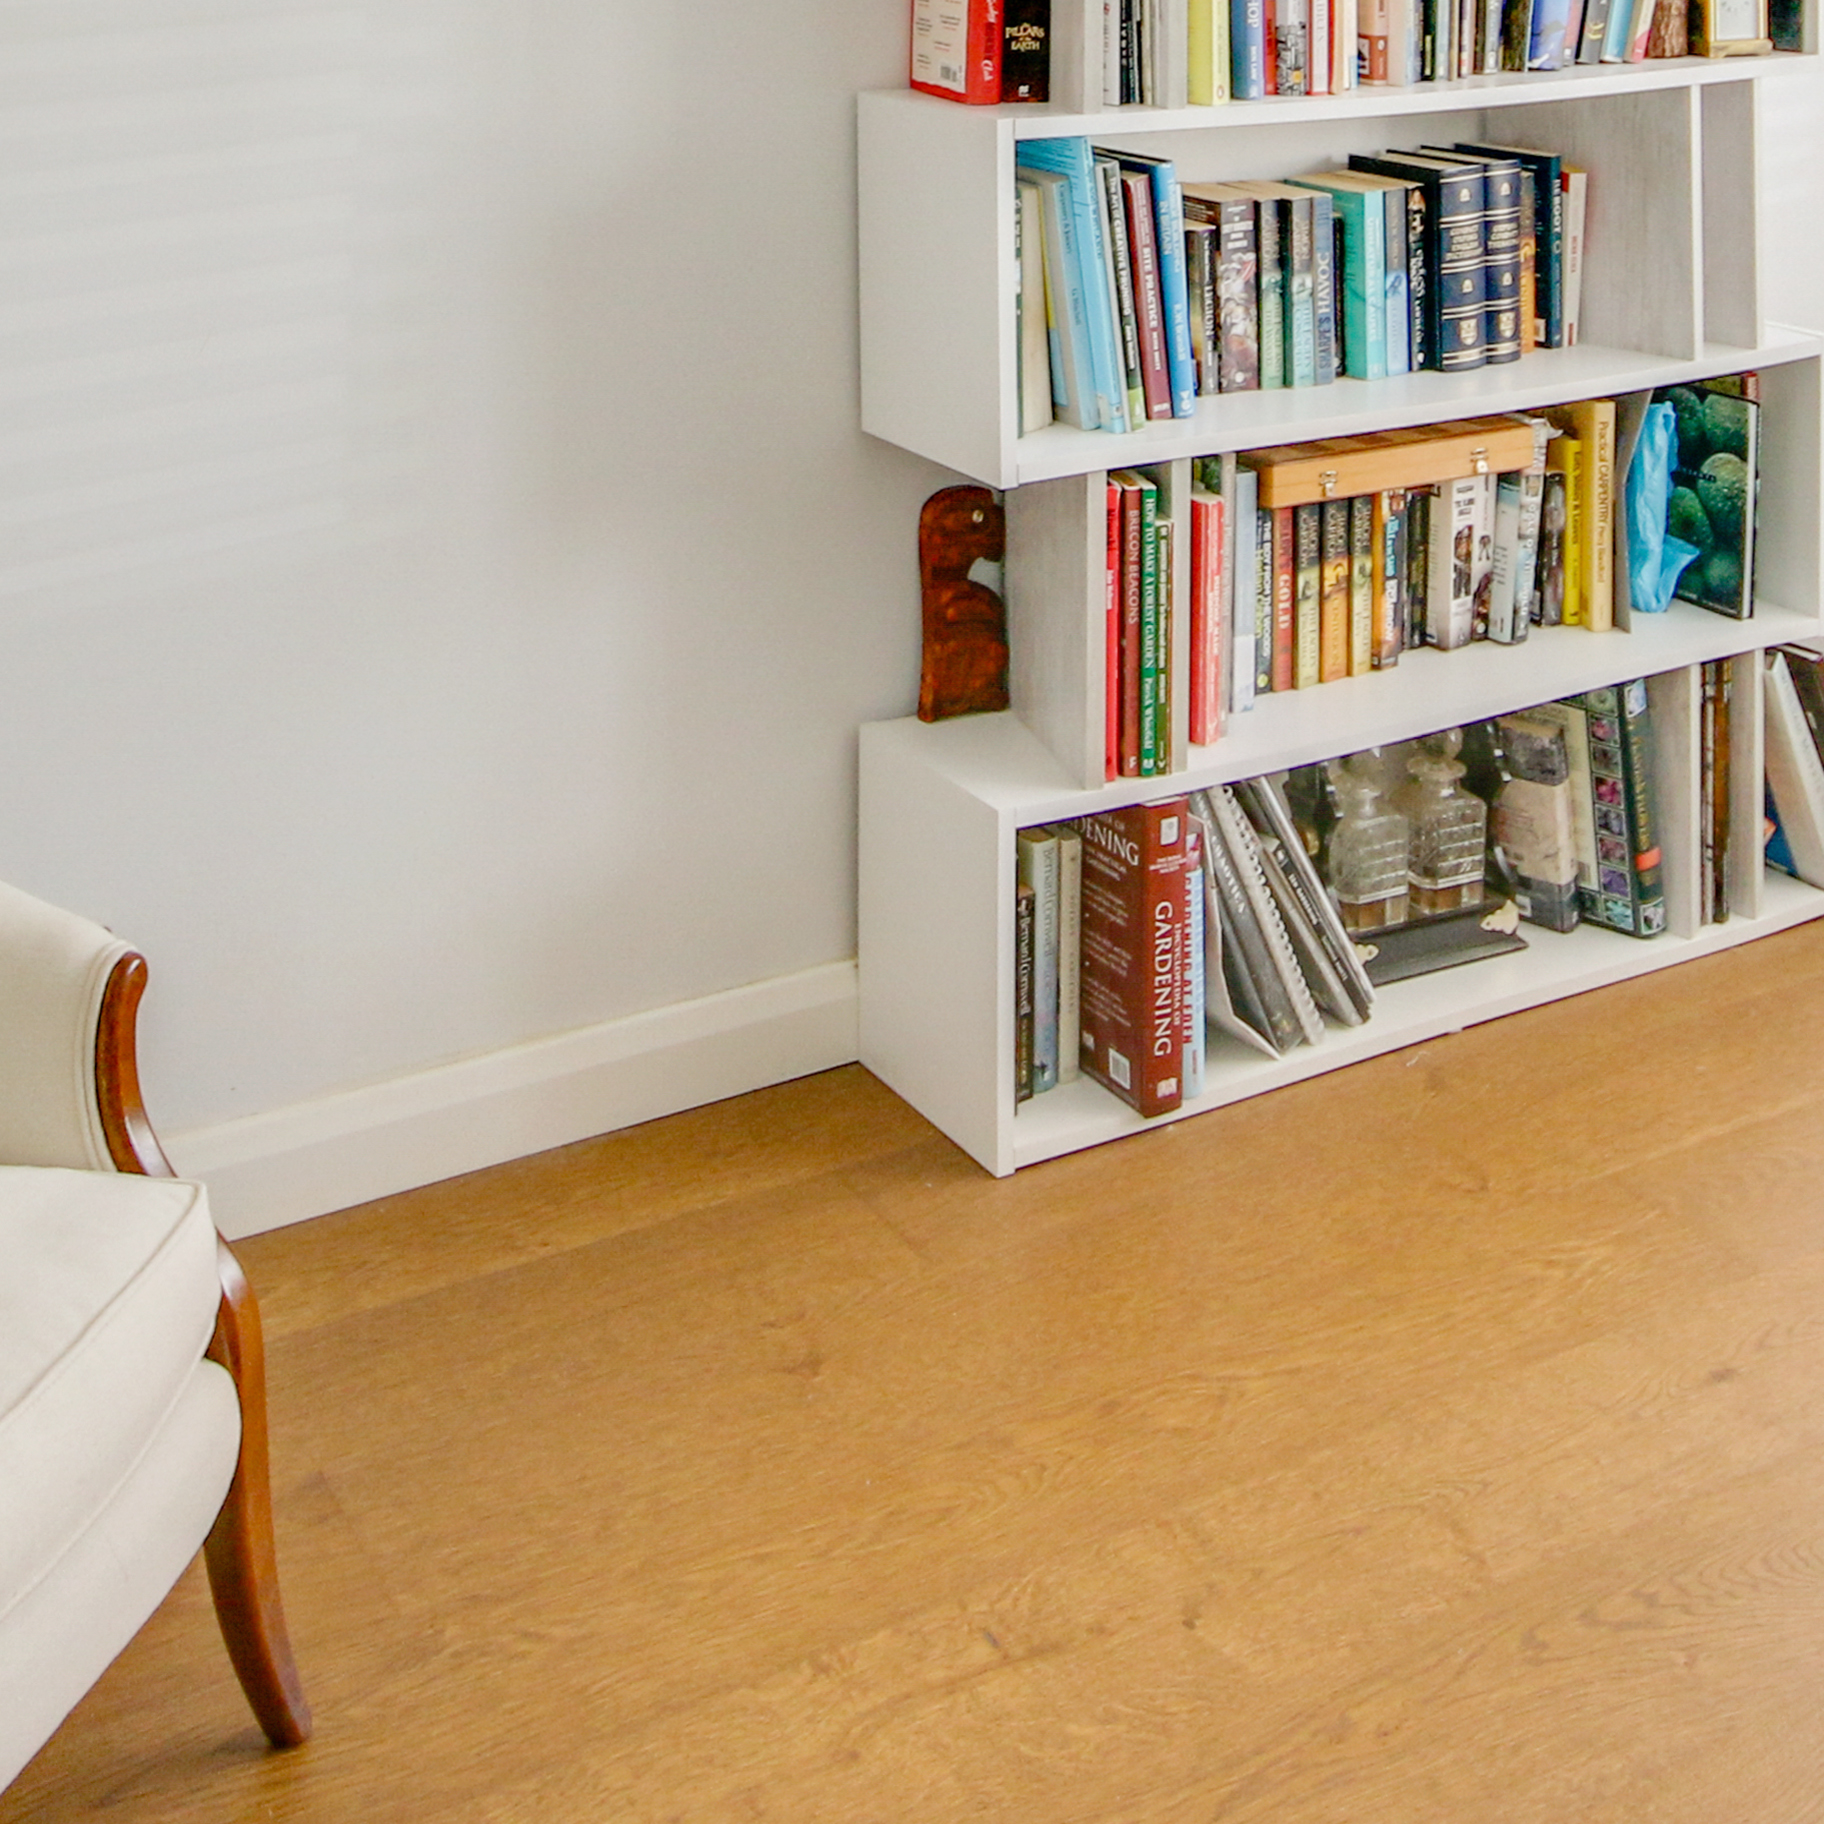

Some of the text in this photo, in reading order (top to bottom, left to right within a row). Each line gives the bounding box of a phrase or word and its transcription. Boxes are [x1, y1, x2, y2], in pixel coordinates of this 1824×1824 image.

[1005, 25, 1045, 39] PILLARS
[1108, 177, 1119, 191] The
[1110, 194, 1120, 207] Art
[1552, 178, 1560, 232] REBOOT
[1112, 219, 1126, 267] CREATIVE
[1159, 200, 1172, 255] IN BRITAIN
[1142, 247, 1152, 270] SITE
[1367, 216, 1375, 341] UNNATURAL CAUSES
[1117, 270, 1131, 315] PRUNING
[1144, 275, 1157, 327] PRACTICE
[1204, 286, 1213, 335] LEGION
[1317, 252, 1330, 368] SHARPE'S HAVOC
[1596, 421, 1608, 523] Practical CARPENTRY
[1145, 497, 1155, 523] HOW
[1337, 510, 1346, 551] SIMON
[1144, 527, 1155, 541] TO
[1126, 509, 1140, 623] BRECON BEACONS
[1144, 544, 1155, 574] MAKE
[1143, 585, 1154, 622] FOREST
[1221, 585, 1229, 615] World
[1278, 573, 1290, 628] GOLD
[1143, 624, 1154, 668] GARDEN
[1042, 847, 1057, 956] Bernard Cornwell
[1021, 916, 1033, 961] Bernard
[1020, 962, 1032, 1015] Cornwell
[1153, 900, 1174, 1058] GARDENING
[1173, 922, 1182, 1025] ENCYCLOPEDIA OF
[1184, 979, 1192, 996] AT
[1182, 1004, 1191, 1044] EDEN
